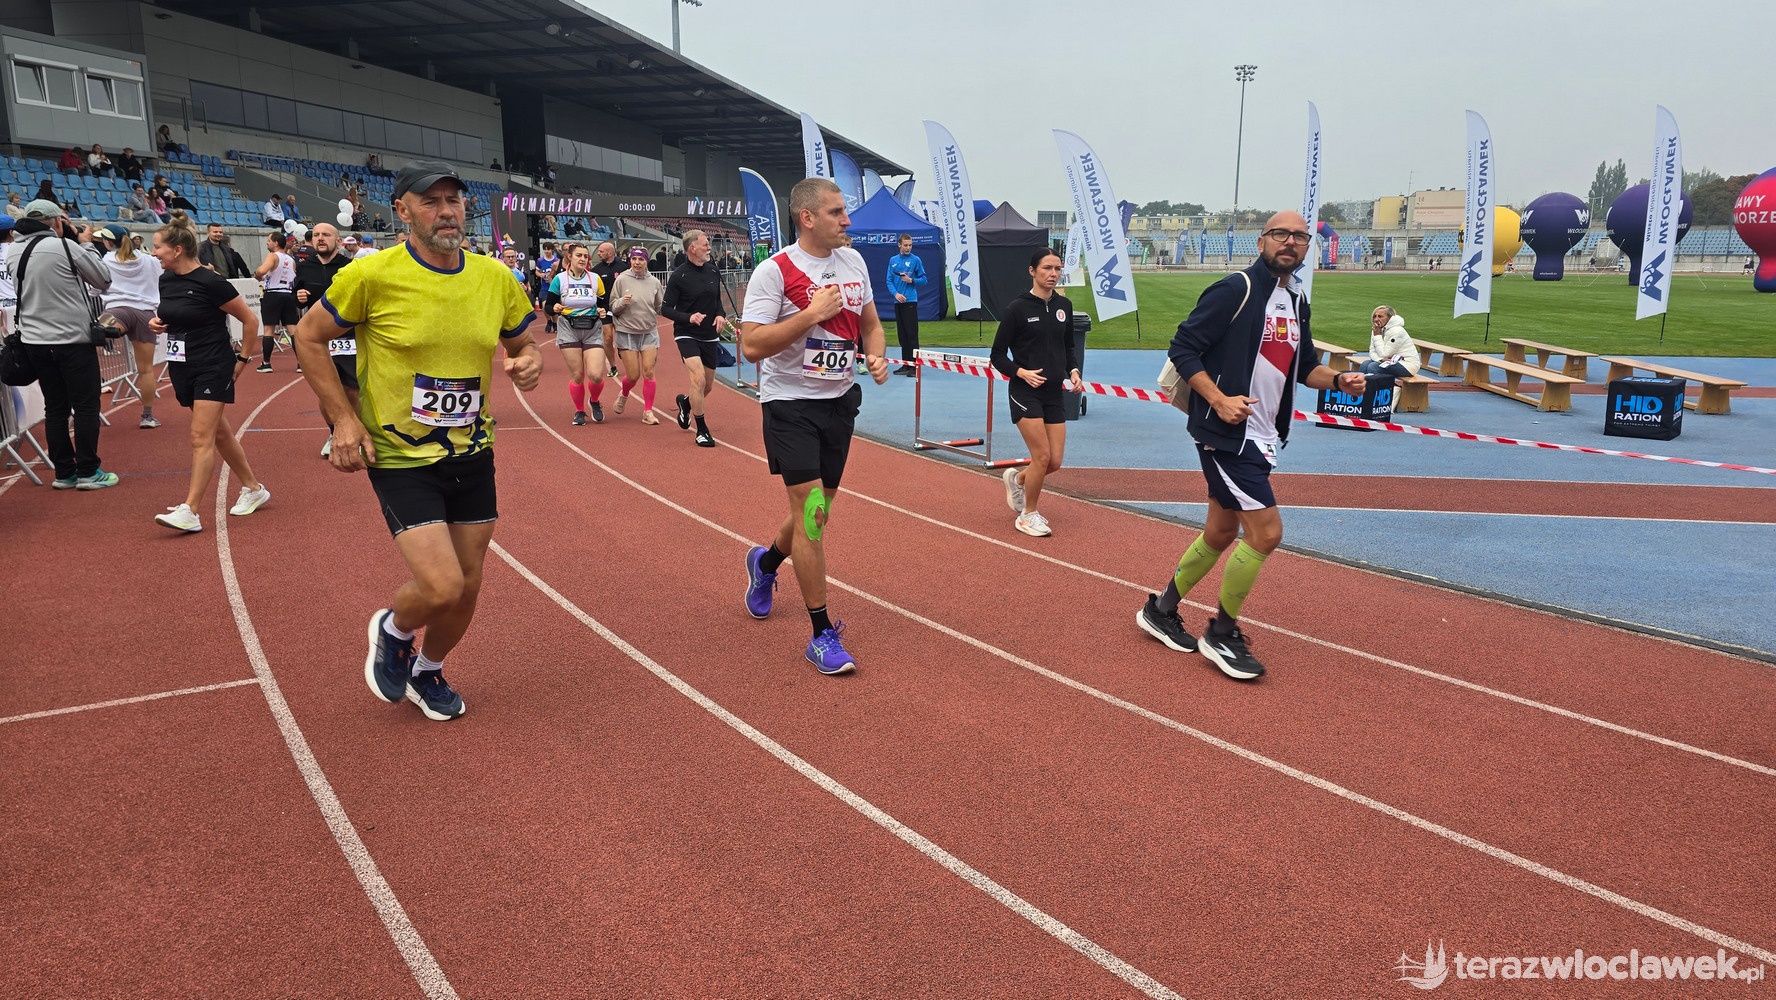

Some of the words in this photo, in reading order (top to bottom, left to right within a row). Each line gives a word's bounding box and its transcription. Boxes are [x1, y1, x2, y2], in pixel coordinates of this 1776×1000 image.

[502, 194, 592, 213] PÓŁMARATON
[618, 203, 656, 212] 00:00:00
[687, 200, 748, 215] WŁOCŁA
[573, 288, 589, 297] 418
[331, 340, 351, 350] 633
[811, 351, 848, 369] 406
[422, 391, 473, 414] 209
[1615, 394, 1663, 414] HID
[1324, 403, 1362, 414] RATION
[1372, 405, 1392, 415] RATION
[1614, 413, 1662, 422] RATION
